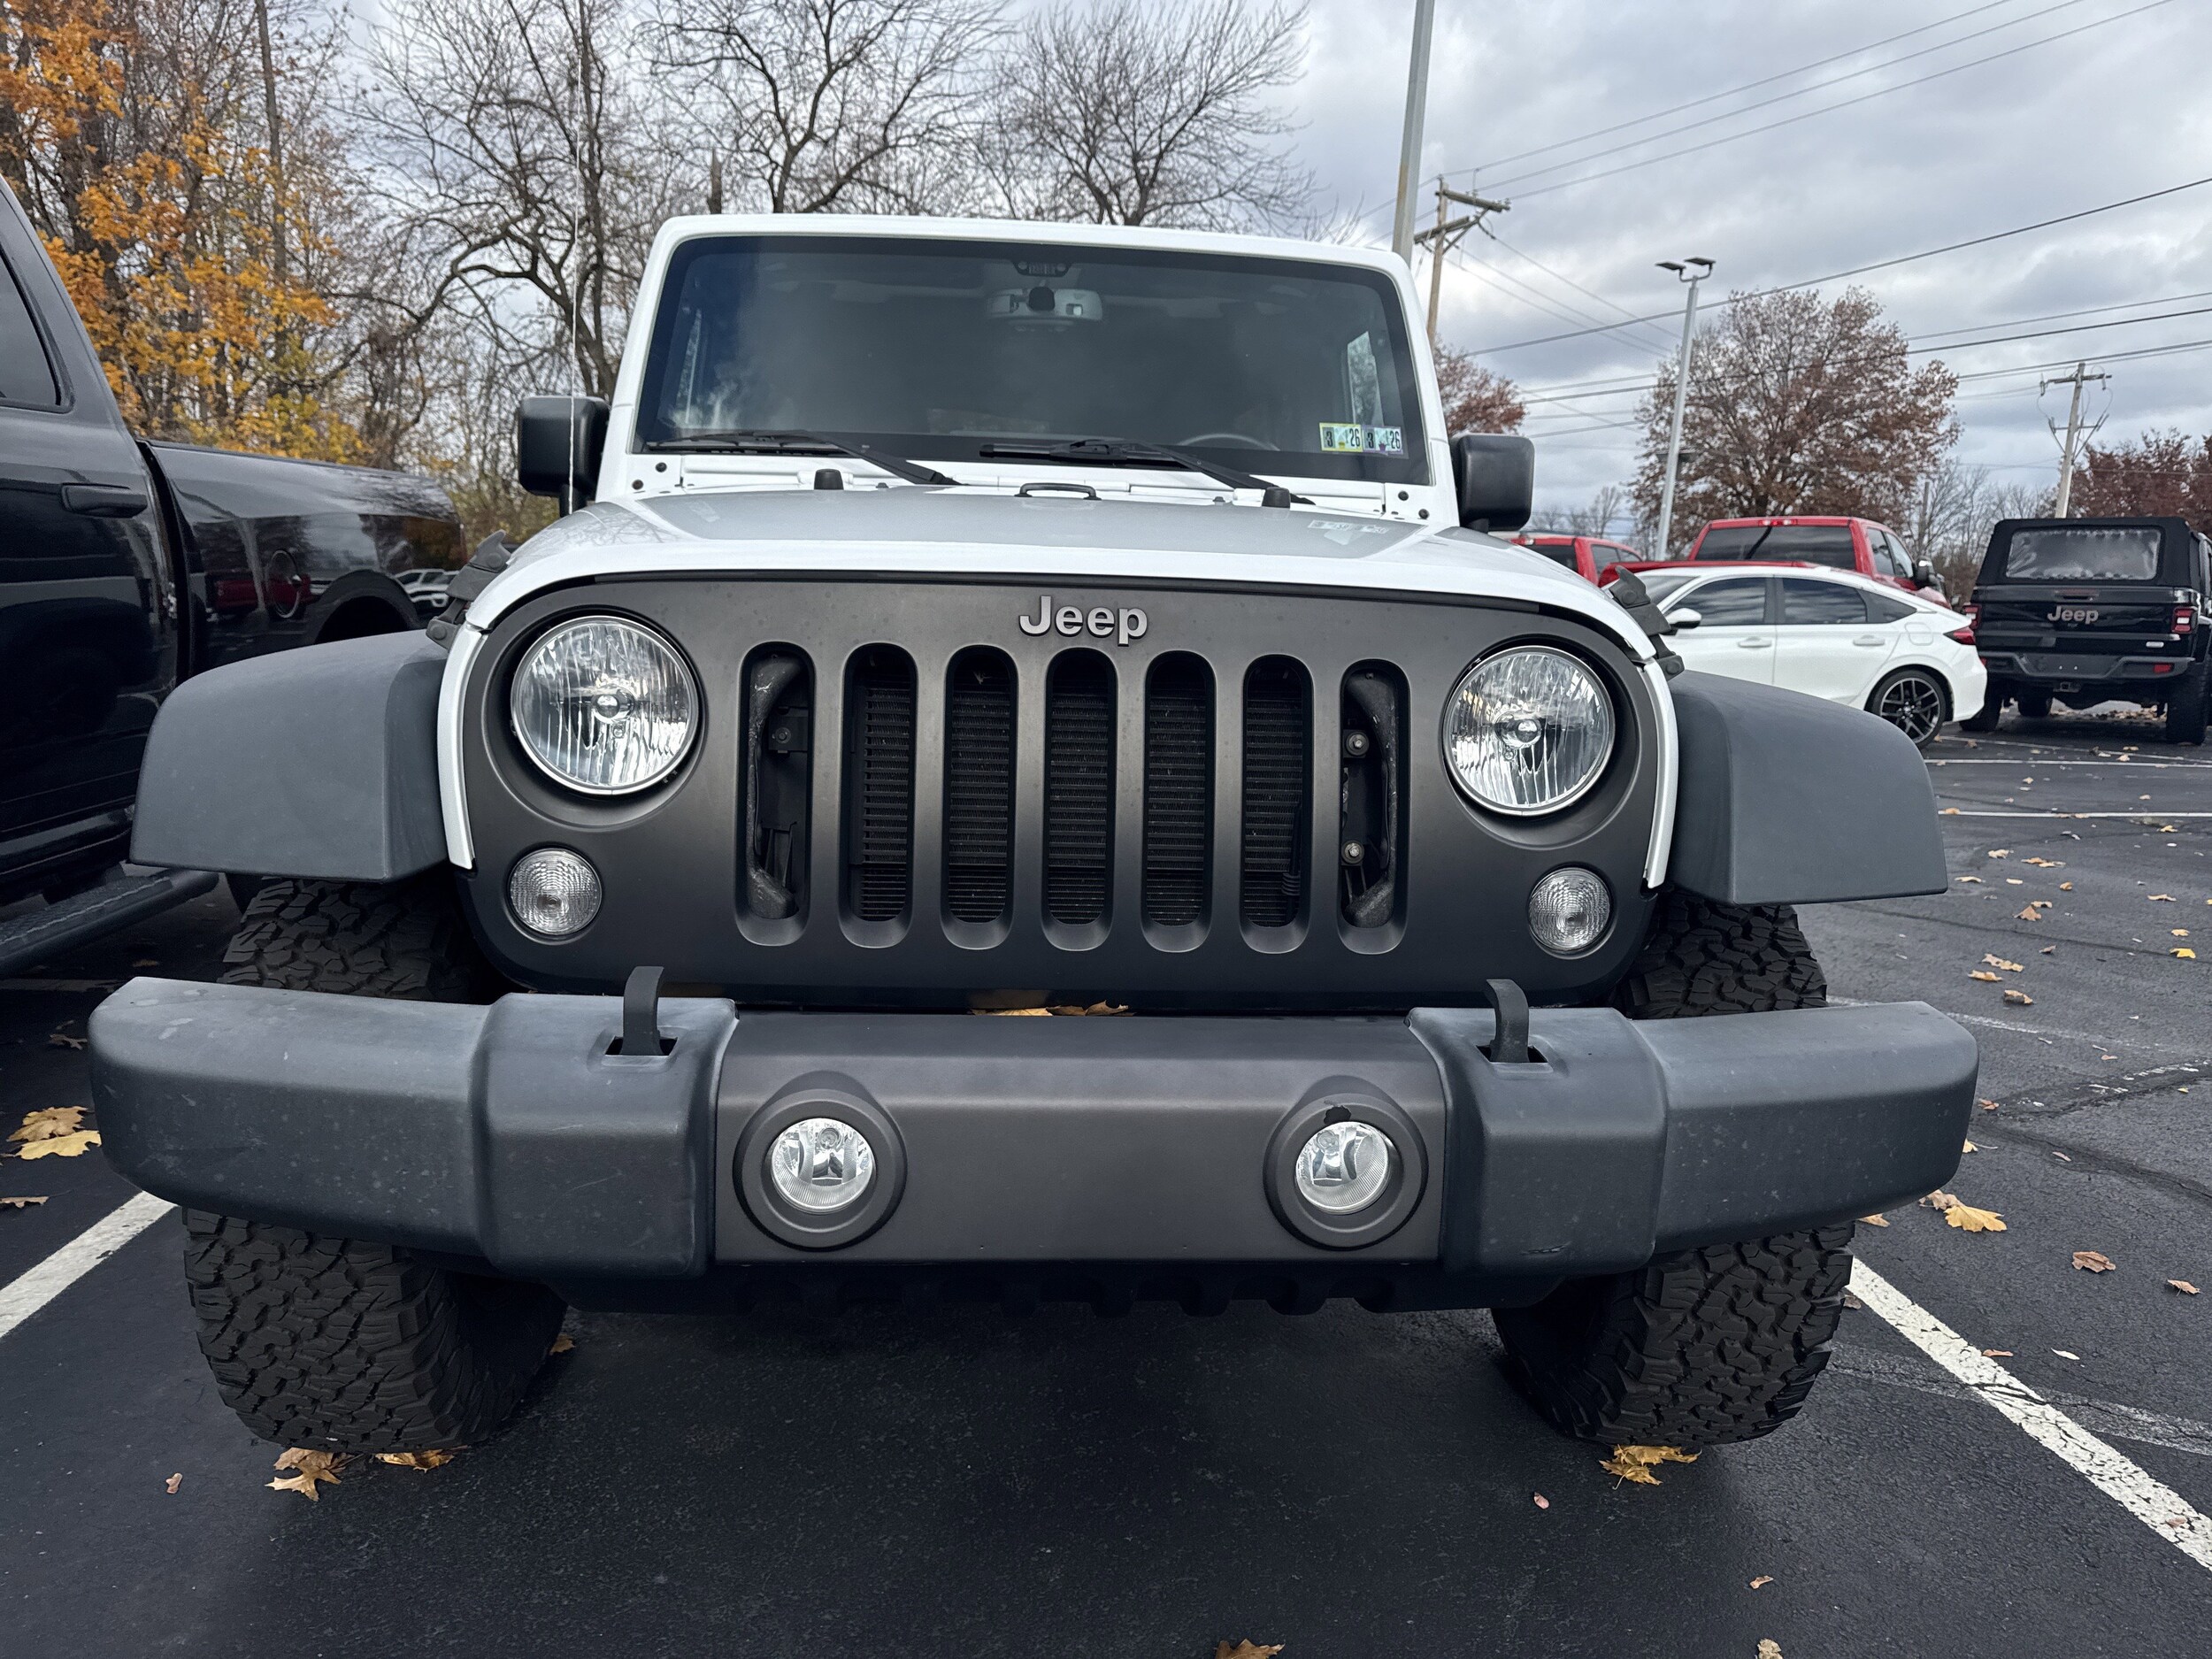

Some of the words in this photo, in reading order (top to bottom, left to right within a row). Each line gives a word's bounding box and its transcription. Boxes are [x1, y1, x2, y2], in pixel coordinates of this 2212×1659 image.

[1349, 428, 1361, 447] 26
[1390, 430, 1401, 449] 26
[1018, 595, 1148, 647] Jeep
[2047, 605, 2099, 624] Jeep
